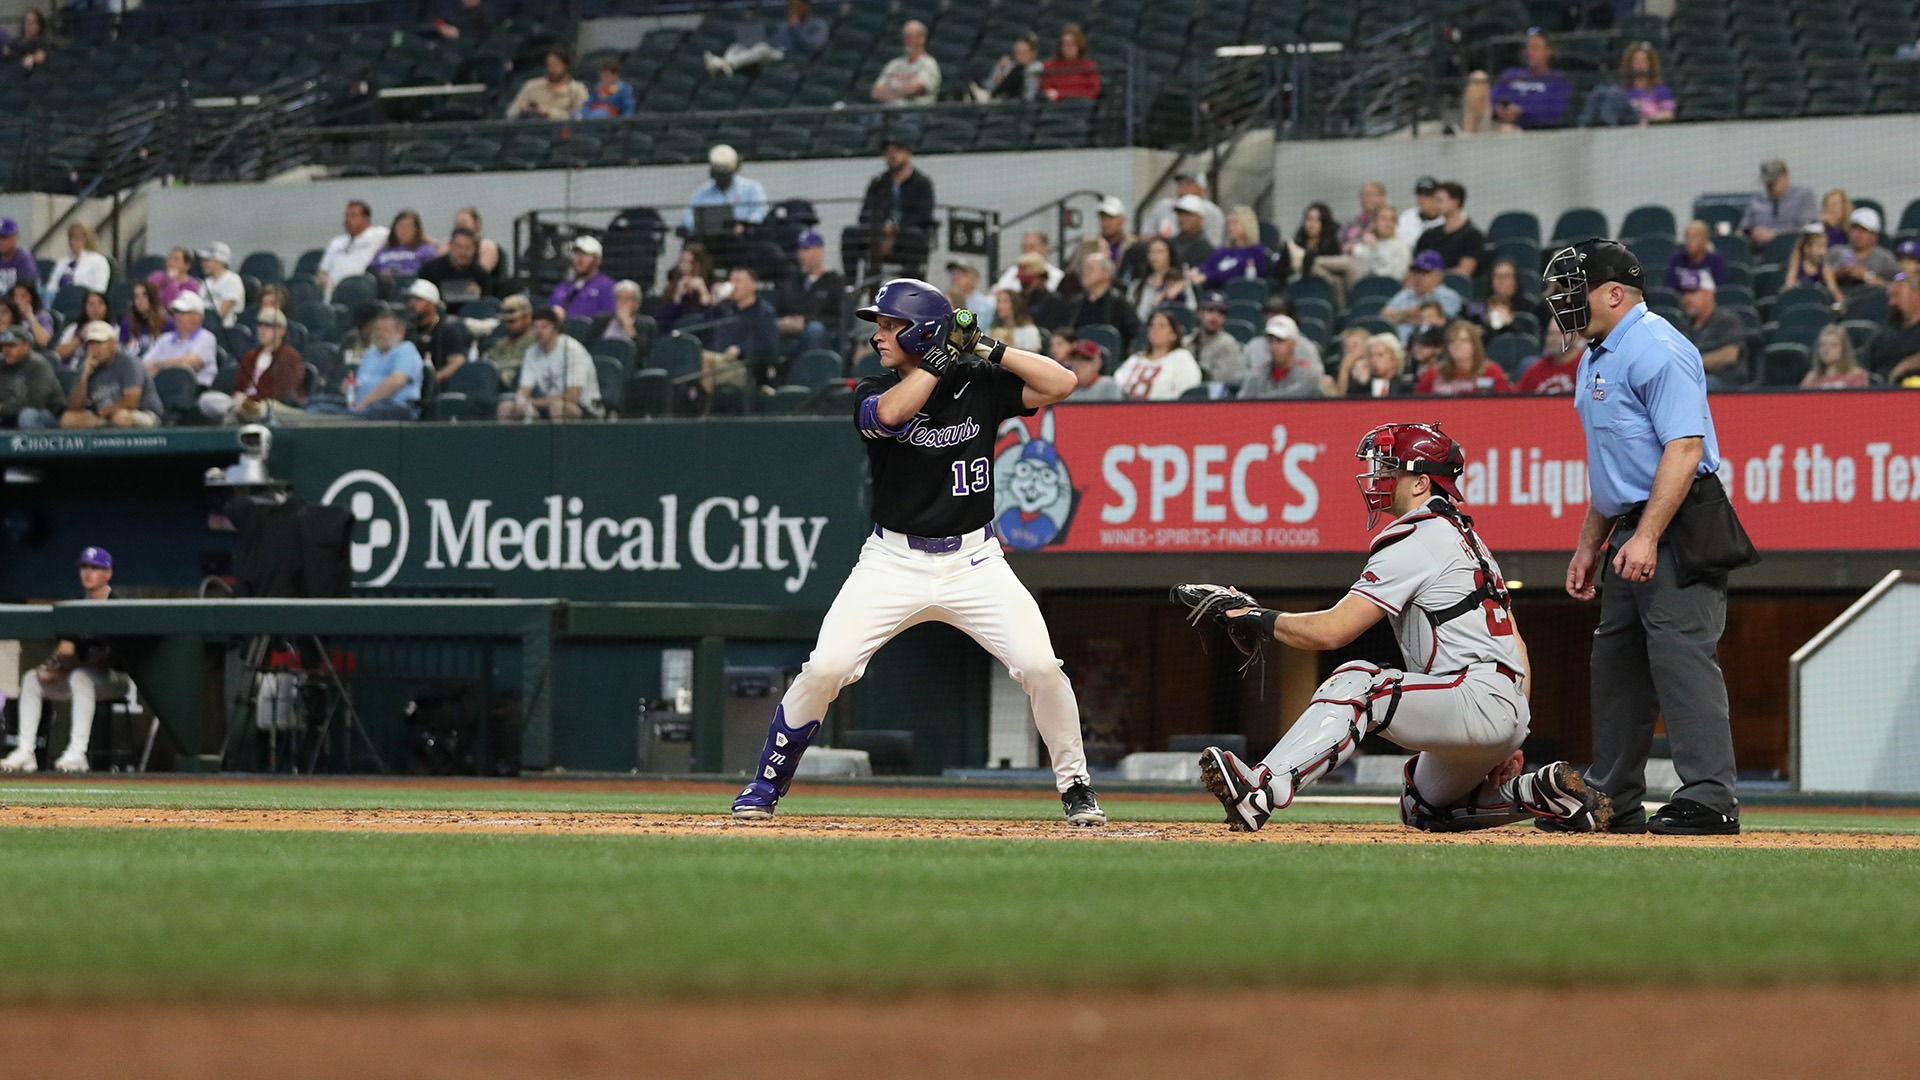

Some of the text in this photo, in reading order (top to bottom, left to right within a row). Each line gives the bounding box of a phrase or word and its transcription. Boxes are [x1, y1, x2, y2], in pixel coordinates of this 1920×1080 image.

[896, 411, 980, 448] Texans
[951, 457, 990, 497] 13
[1100, 424, 1319, 524] SPEC'S
[1510, 447, 1591, 519] Liqu
[1744, 443, 1785, 504] of
[1793, 442, 1856, 504] the
[424, 494, 829, 593] Medical City
[1266, 527, 1319, 546] FOODS
